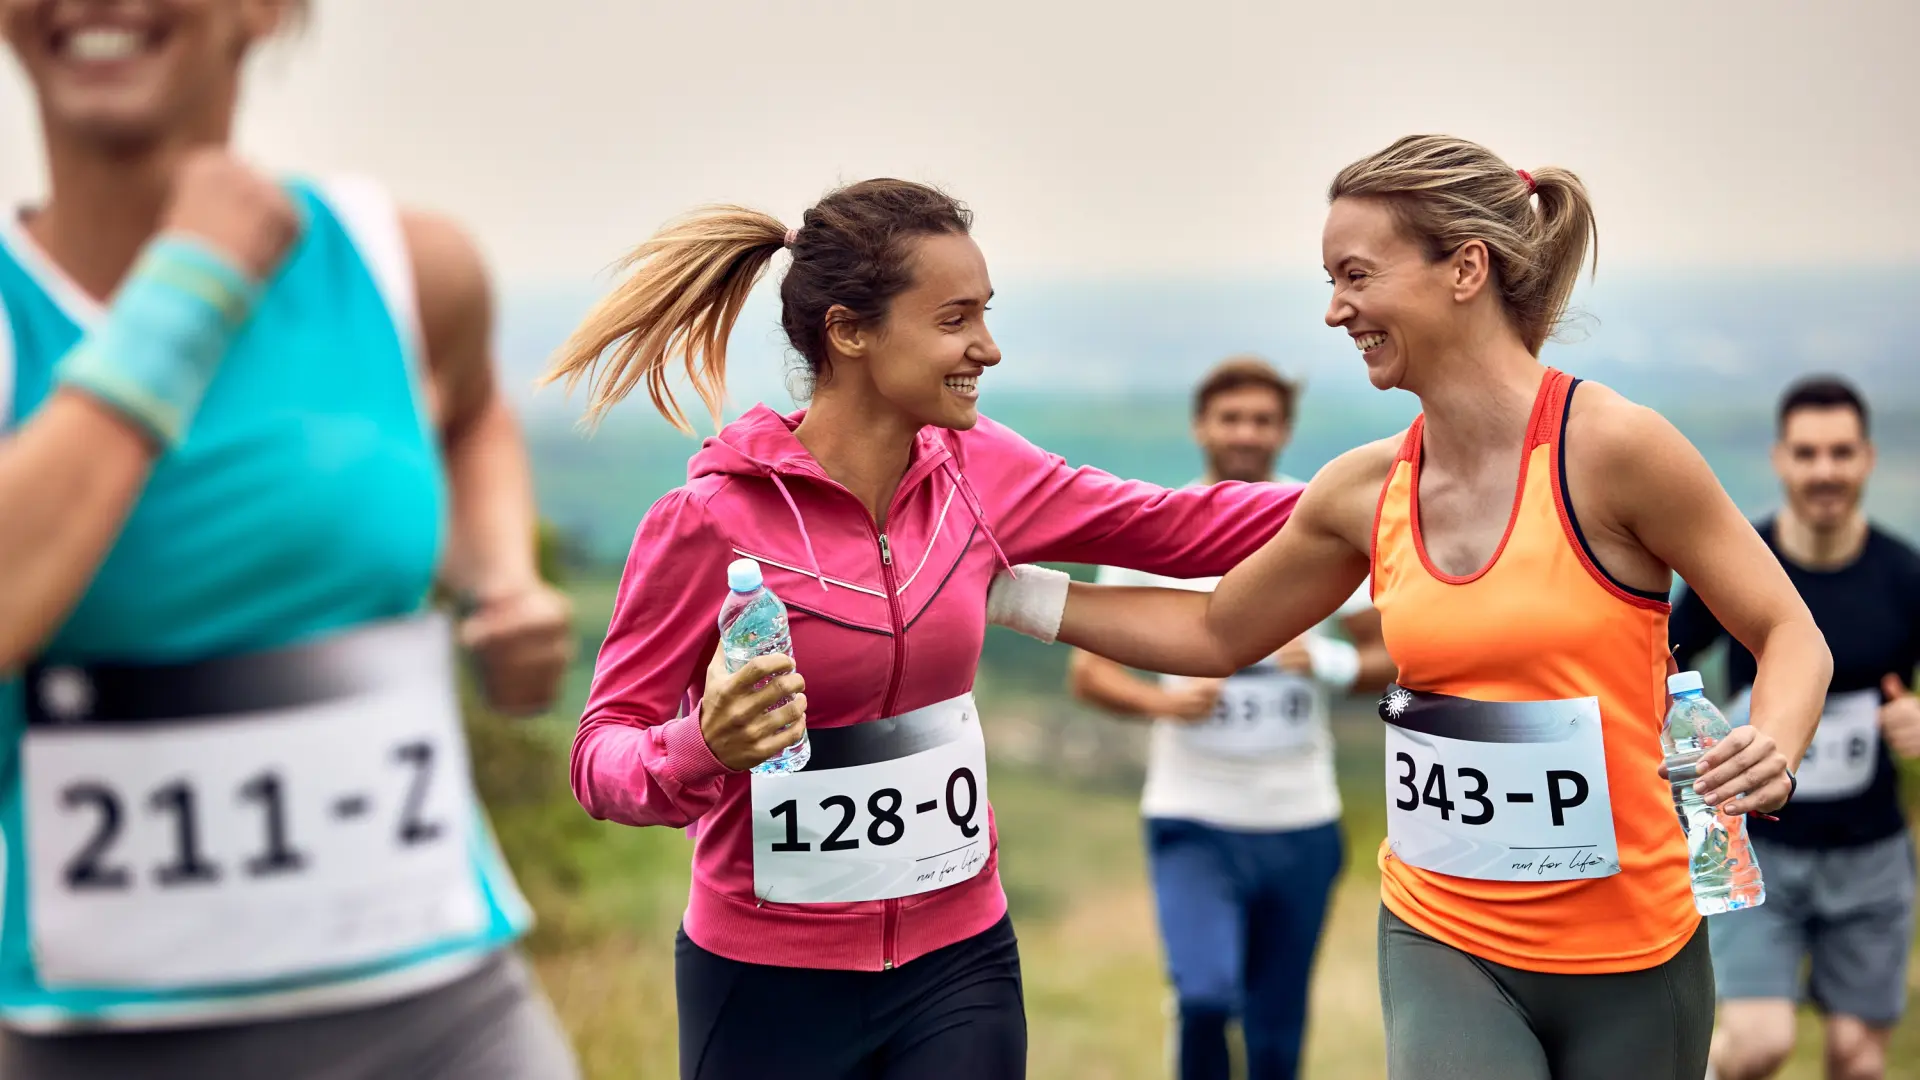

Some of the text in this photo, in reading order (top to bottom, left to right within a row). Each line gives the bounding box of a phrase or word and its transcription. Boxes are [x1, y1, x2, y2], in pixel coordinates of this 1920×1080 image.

[769, 767, 980, 852] 128-Q
[1396, 752, 1589, 826] 343-P
[917, 870, 934, 882] run
[940, 861, 957, 882] for
[1511, 850, 1599, 875] run for life
